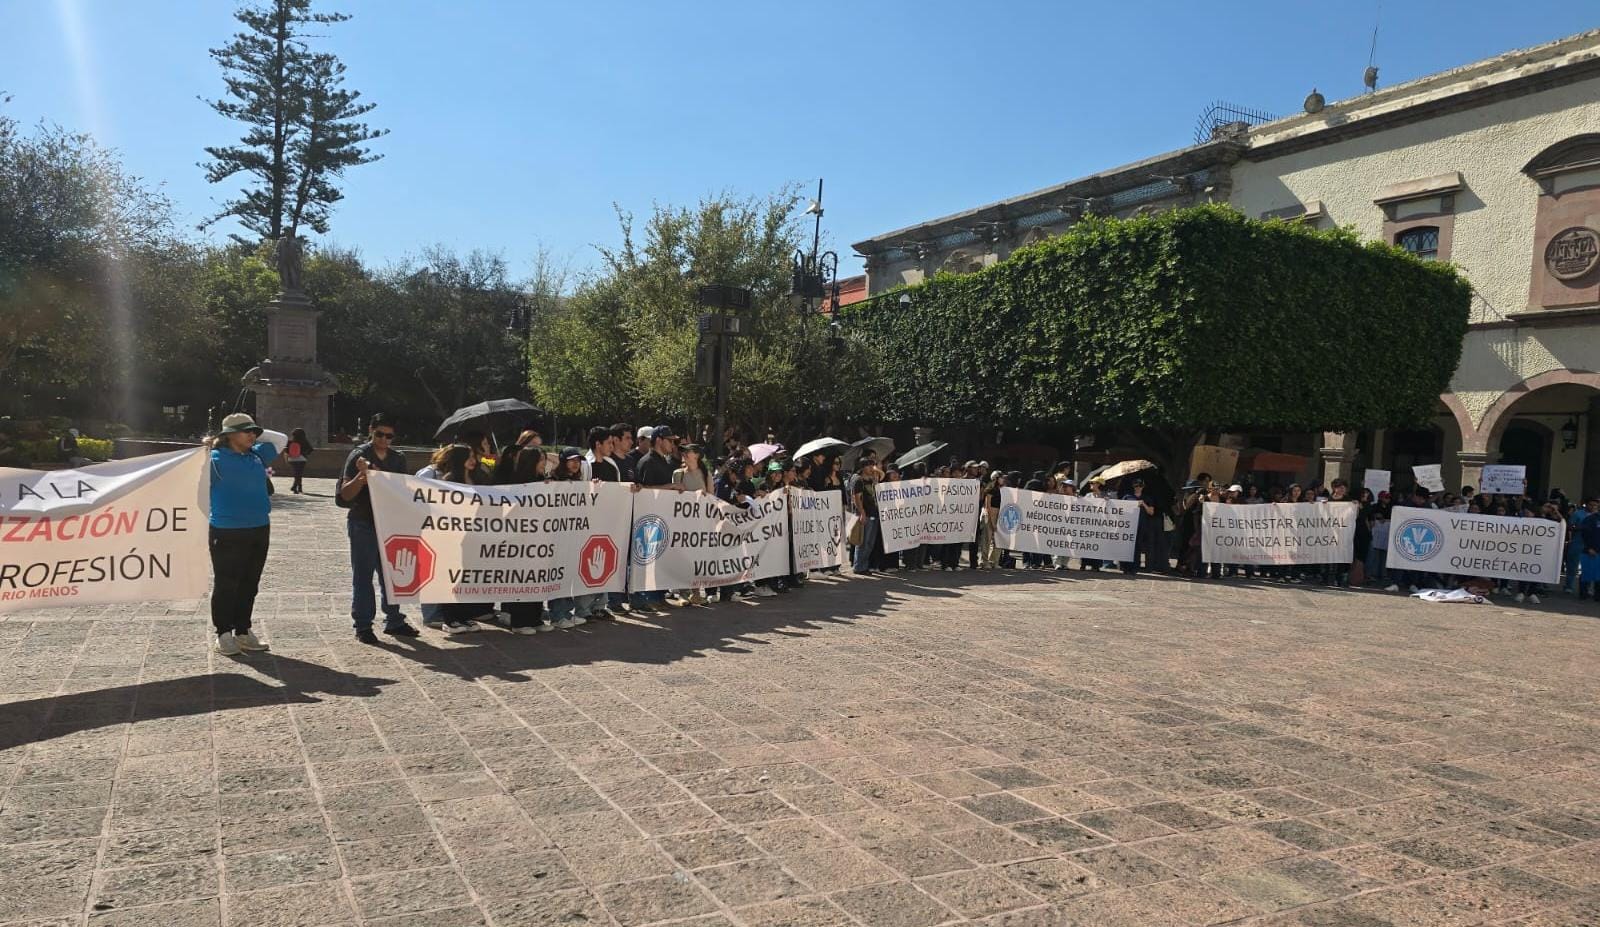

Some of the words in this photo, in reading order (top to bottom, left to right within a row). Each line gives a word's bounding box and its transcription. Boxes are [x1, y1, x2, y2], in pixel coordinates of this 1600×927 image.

[19, 483, 45, 500] A
[50, 480, 97, 498] LA
[413, 488, 465, 505] ALTO
[470, 492, 484, 506] A
[488, 494, 512, 507] LA
[514, 493, 587, 507] VIOLENCIA
[590, 493, 599, 506] Y
[674, 501, 700, 518] POR
[880, 506, 918, 522] ENTREGA
[937, 504, 948, 514] LA
[949, 503, 975, 514] SALUD
[1033, 500, 1069, 511] COLEGIO
[1071, 504, 1109, 514] ESTATAL
[1112, 507, 1124, 516] DE
[146, 507, 188, 532] DE
[421, 515, 539, 533] AGRESIONES
[543, 517, 590, 532] CONTRA
[1026, 511, 1063, 522] MÉDICOS
[1064, 516, 1130, 528] VETERINARIOS
[1211, 517, 1225, 528] EL
[1228, 518, 1293, 530] BIENESTAR
[1297, 517, 1348, 528] ANIMAL
[1450, 519, 1556, 537] VETERINARIOS
[892, 528, 903, 539] DE
[904, 524, 920, 537] TUS
[1021, 523, 1031, 531] DE
[1033, 524, 1077, 537] PEQUEÑAS
[1080, 530, 1120, 540] ESPECIES
[1122, 533, 1135, 541] DE
[479, 540, 555, 559] MÉDICOS
[1046, 540, 1099, 551] QUERÉTARO
[1215, 536, 1281, 548] COMIENZA
[1284, 536, 1302, 547] EN
[1305, 535, 1338, 547] CASA
[1459, 538, 1518, 553] UNIDOS
[1521, 544, 1543, 555] DE
[1450, 556, 1542, 575] QUERÉTARO
[449, 567, 565, 584] VETERINARIOS
[29, 586, 79, 599] MENOS
[451, 586, 462, 594] NI
[481, 586, 540, 594] VETERINARIO
